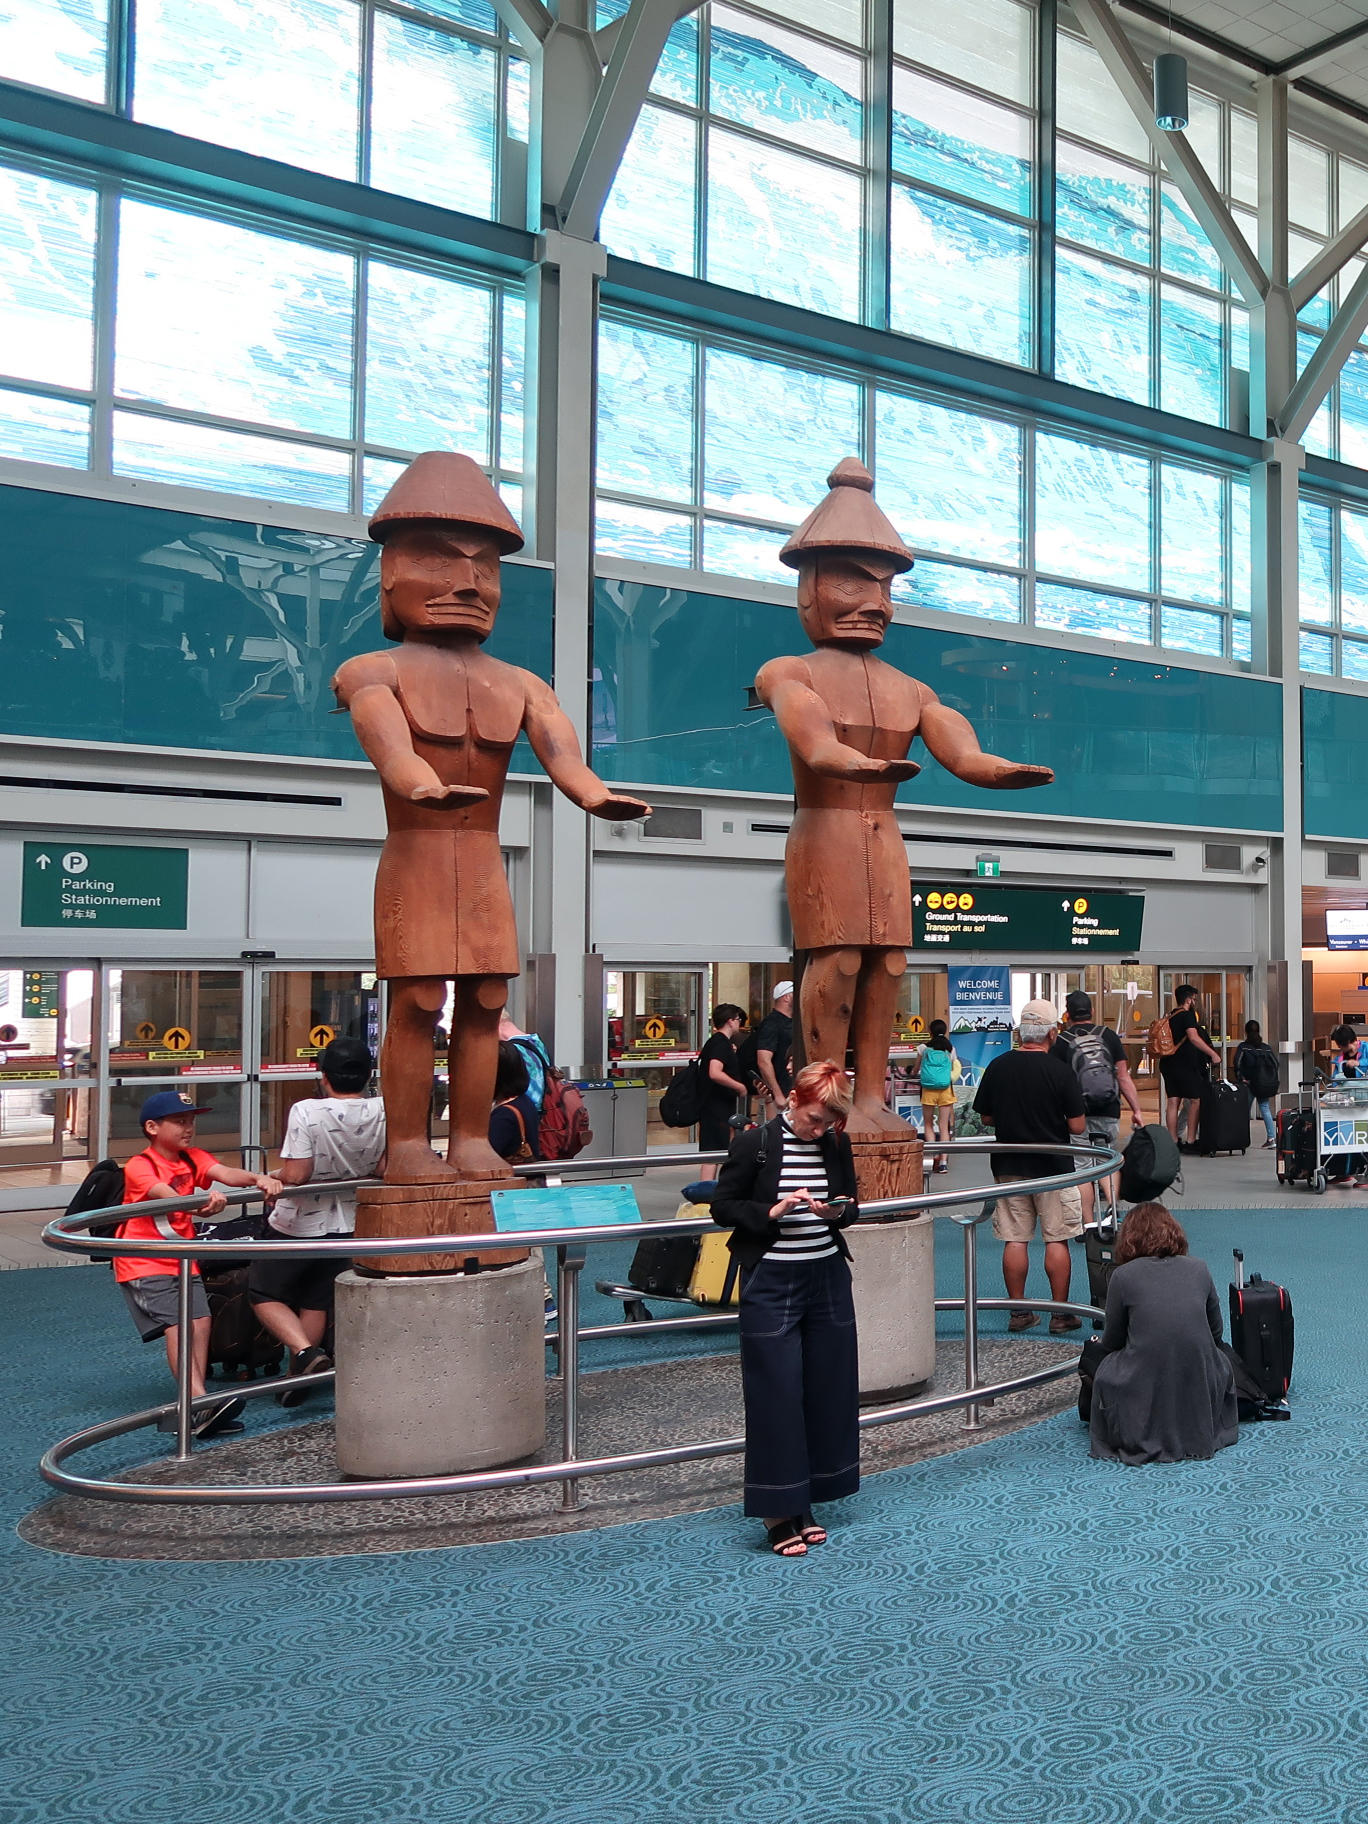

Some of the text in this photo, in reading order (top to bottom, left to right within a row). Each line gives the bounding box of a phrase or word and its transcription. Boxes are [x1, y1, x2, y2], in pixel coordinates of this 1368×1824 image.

[69, 856, 83, 870] P
[61, 878, 115, 893] Parking
[61, 893, 161, 906] Stationnement
[1078, 902, 1084, 911] P
[61, 908, 97, 919] 停车场
[925, 911, 1009, 923] Ground Transportation
[1072, 916, 1098, 927] Parking
[925, 923, 961, 933] Transport
[973, 924, 985, 932] sol
[1071, 927, 1119, 936] Stationnement
[958, 980, 1000, 988] WELCOME
[956, 991, 1003, 1000] BIENVENUE
[960, 1072, 981, 1087] YV
[1324, 1131, 1368, 1147] YVR
